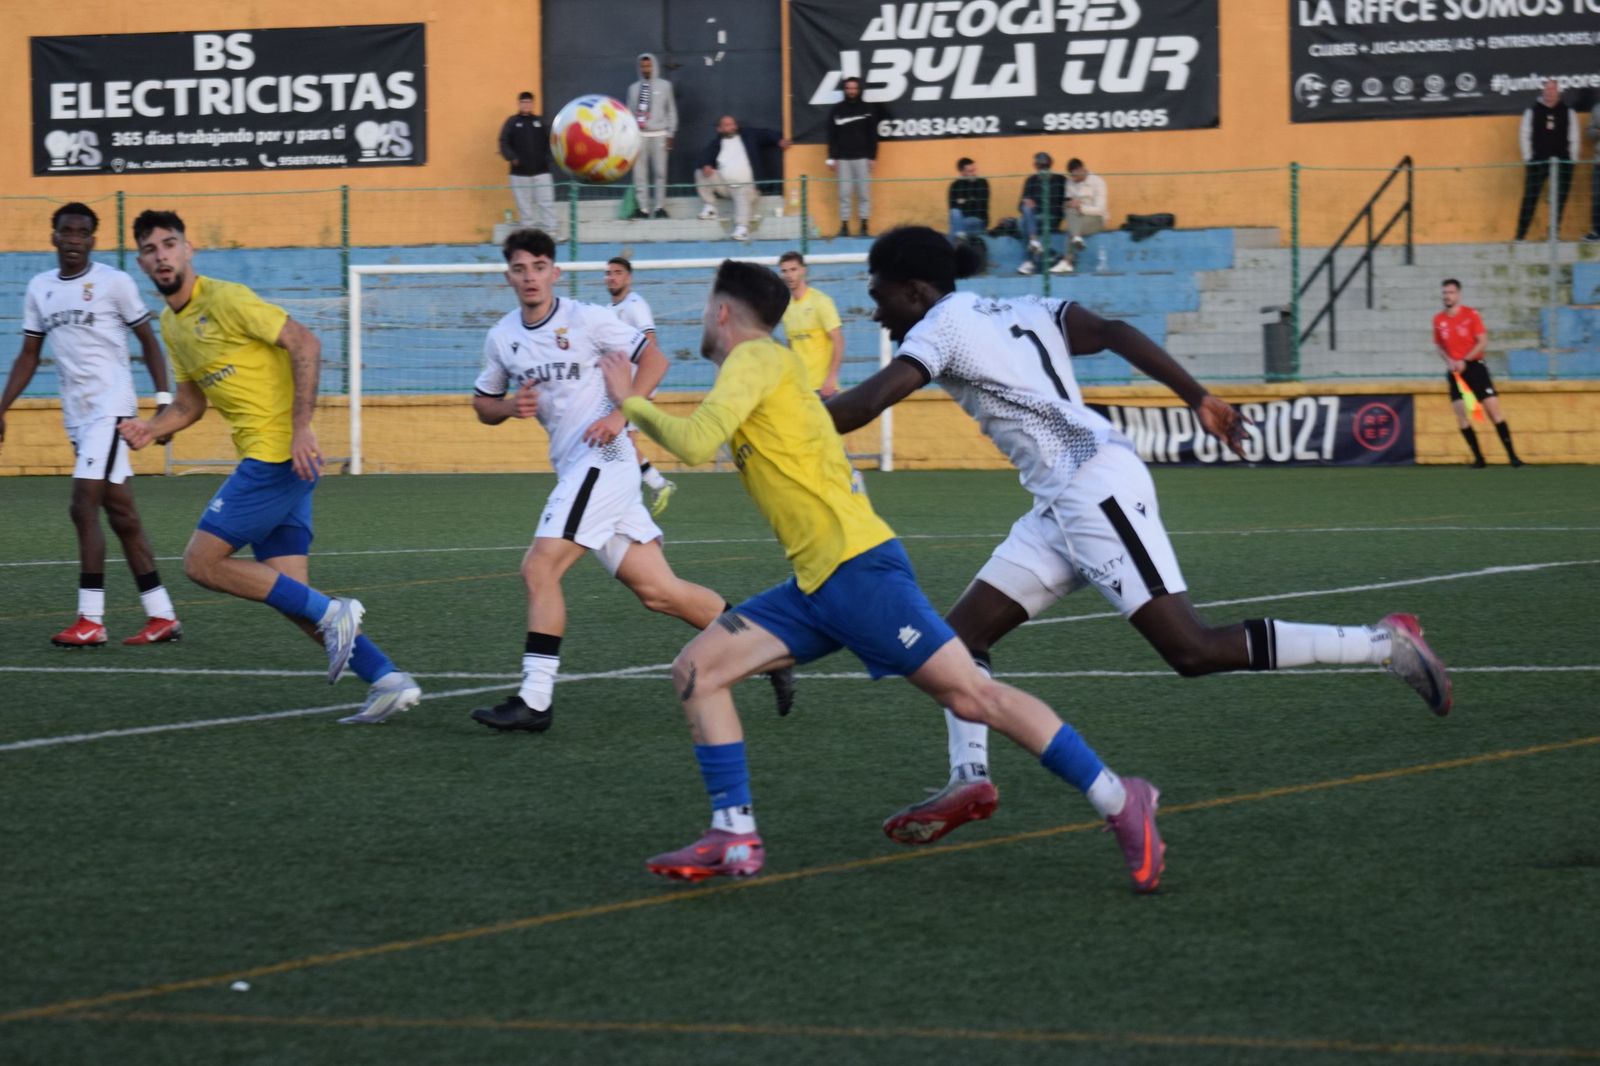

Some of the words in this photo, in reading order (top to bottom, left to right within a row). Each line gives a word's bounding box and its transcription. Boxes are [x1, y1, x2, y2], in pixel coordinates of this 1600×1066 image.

[860, 0, 1141, 41] AUTOCARES
[1298, 0, 1338, 26] LA
[1345, 0, 1438, 24] RFFCE
[1443, 0, 1564, 20] SOMOS
[193, 32, 256, 71] BS
[808, 42, 1037, 105] ABYLA
[1061, 35, 1200, 95] TUR
[49, 71, 417, 119] ELECTRICISTAS
[111, 131, 143, 147] 365
[144, 130, 176, 146] días
[176, 127, 255, 148] trabajando
[256, 130, 282, 146] por
[283, 130, 296, 145] y
[296, 128, 331, 145] para
[877, 115, 1000, 138] 620834902
[1043, 109, 1169, 131] 956510695
